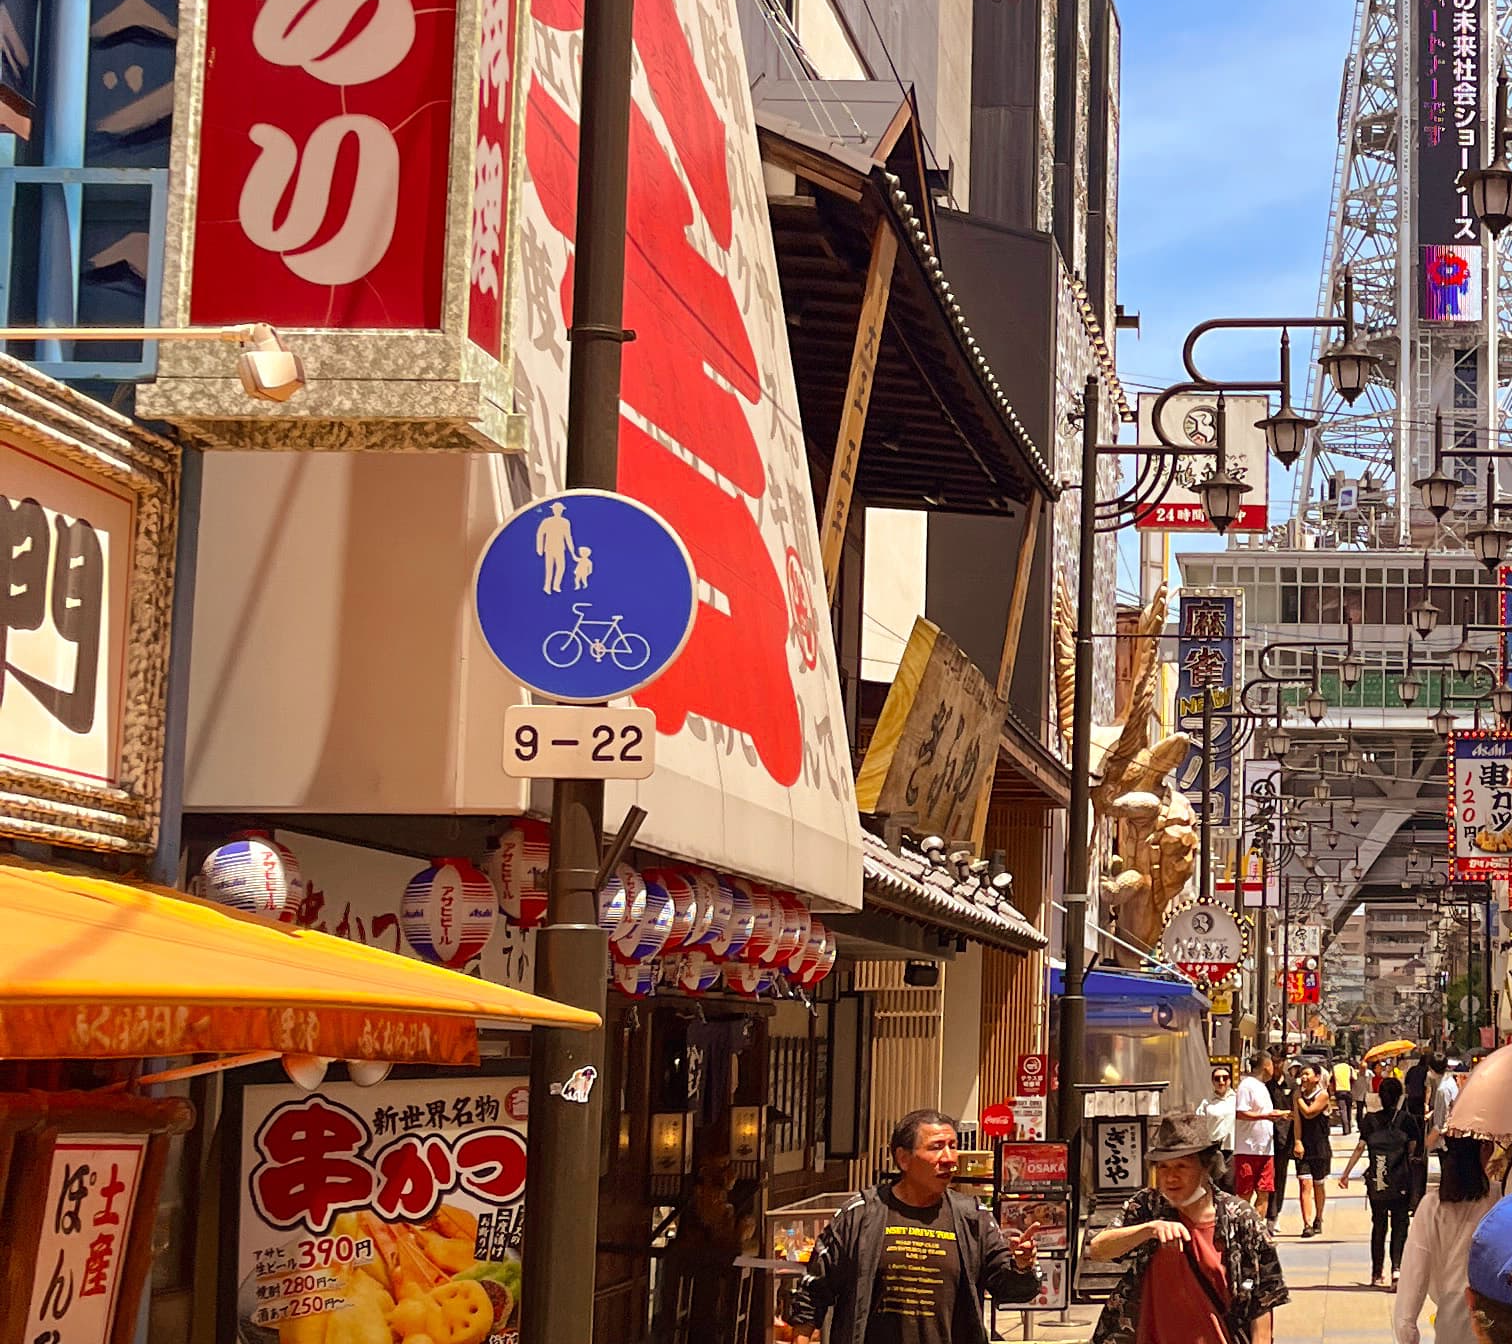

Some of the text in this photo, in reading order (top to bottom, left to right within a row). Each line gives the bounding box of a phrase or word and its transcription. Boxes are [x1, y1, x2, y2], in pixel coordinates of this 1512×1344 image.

[1156, 507, 1247, 523] 24時間中
[1472, 742, 1506, 756] Asahi
[1479, 761, 1512, 833] 串カツ
[439, 885, 454, 946] アサヒビール
[469, 907, 493, 919] Asahi
[373, 1095, 500, 1136] 新世界名物
[252, 1096, 526, 1234] 串かつ
[1027, 1163, 1067, 1174] OSAKA
[1105, 1127, 1129, 1185] ぎふや
[79, 1163, 126, 1298] 土産
[255, 1237, 372, 1276] 生ビール 390円
